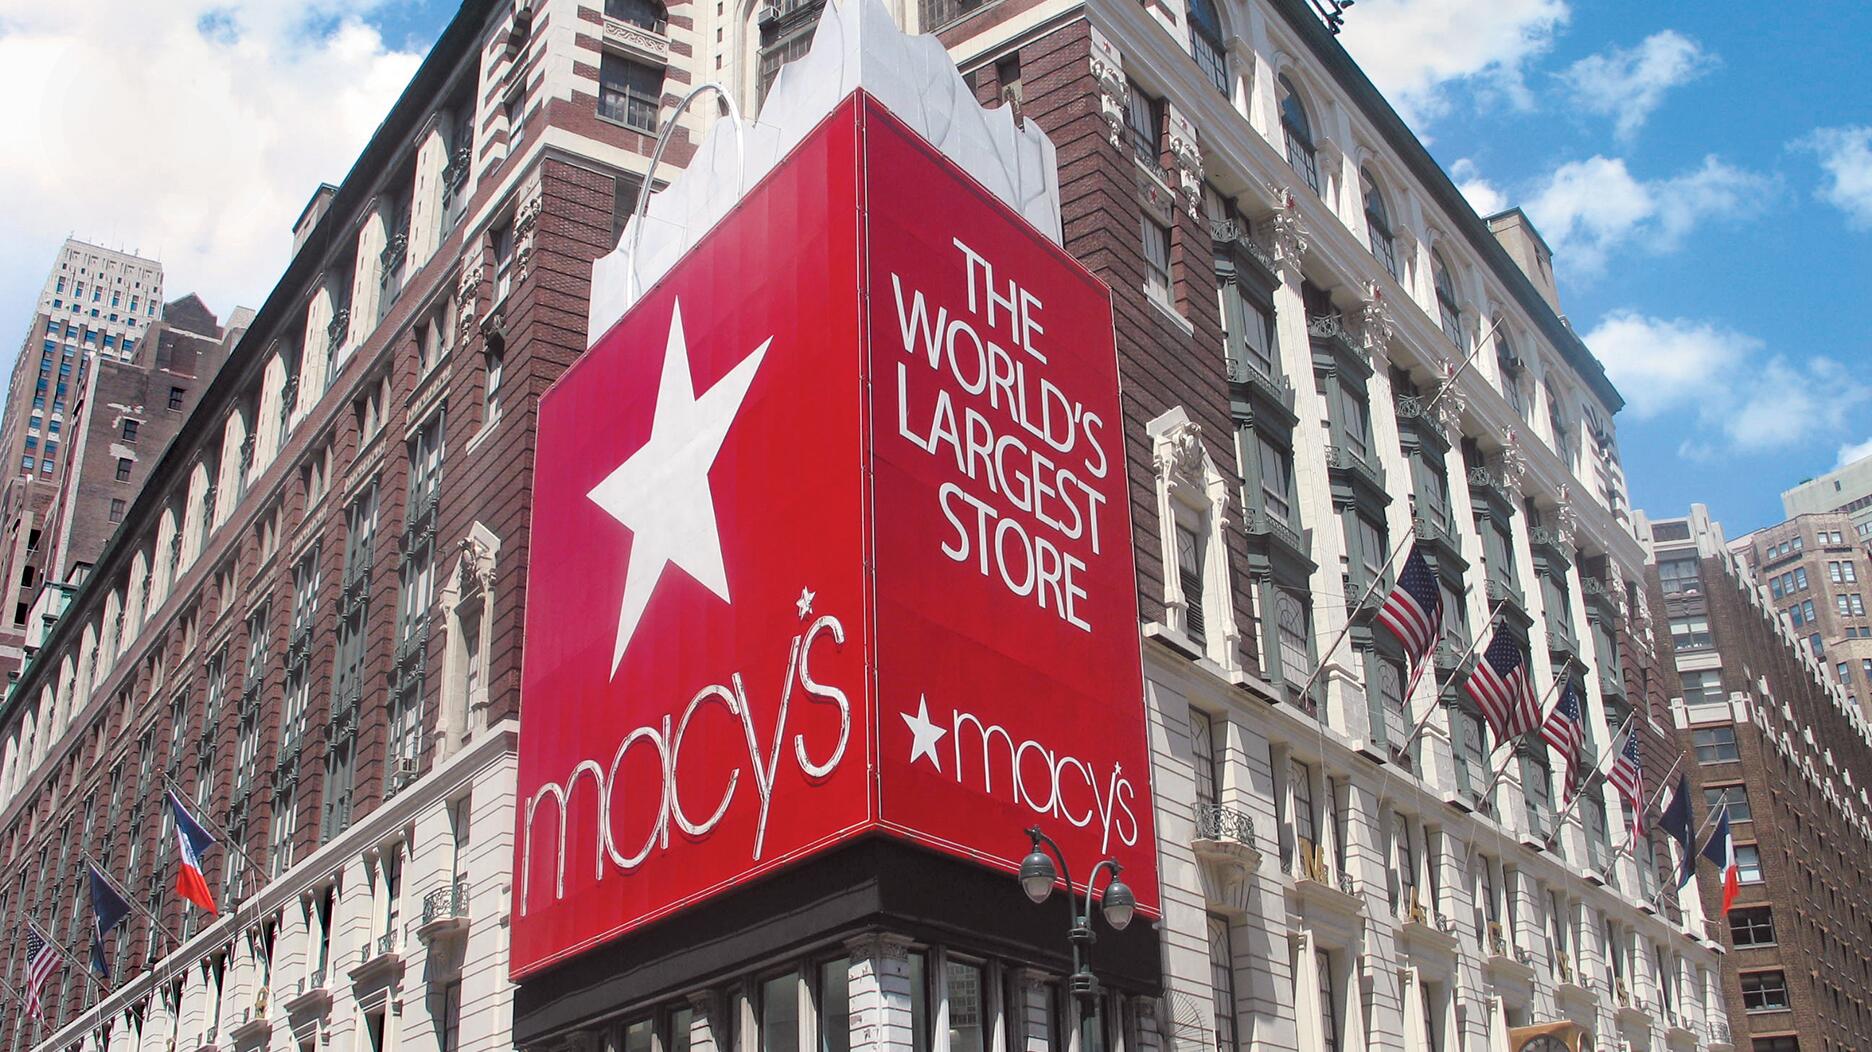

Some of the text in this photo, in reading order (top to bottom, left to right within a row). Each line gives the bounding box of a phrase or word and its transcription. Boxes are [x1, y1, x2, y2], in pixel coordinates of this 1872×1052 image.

[891, 272, 1108, 479] WORLD'S
[952, 236, 1048, 365] THE
[897, 361, 1107, 555] LARGEST
[938, 482, 1091, 633] STORE
[518, 587, 851, 918] macy's
[953, 709, 1138, 855] macy's
